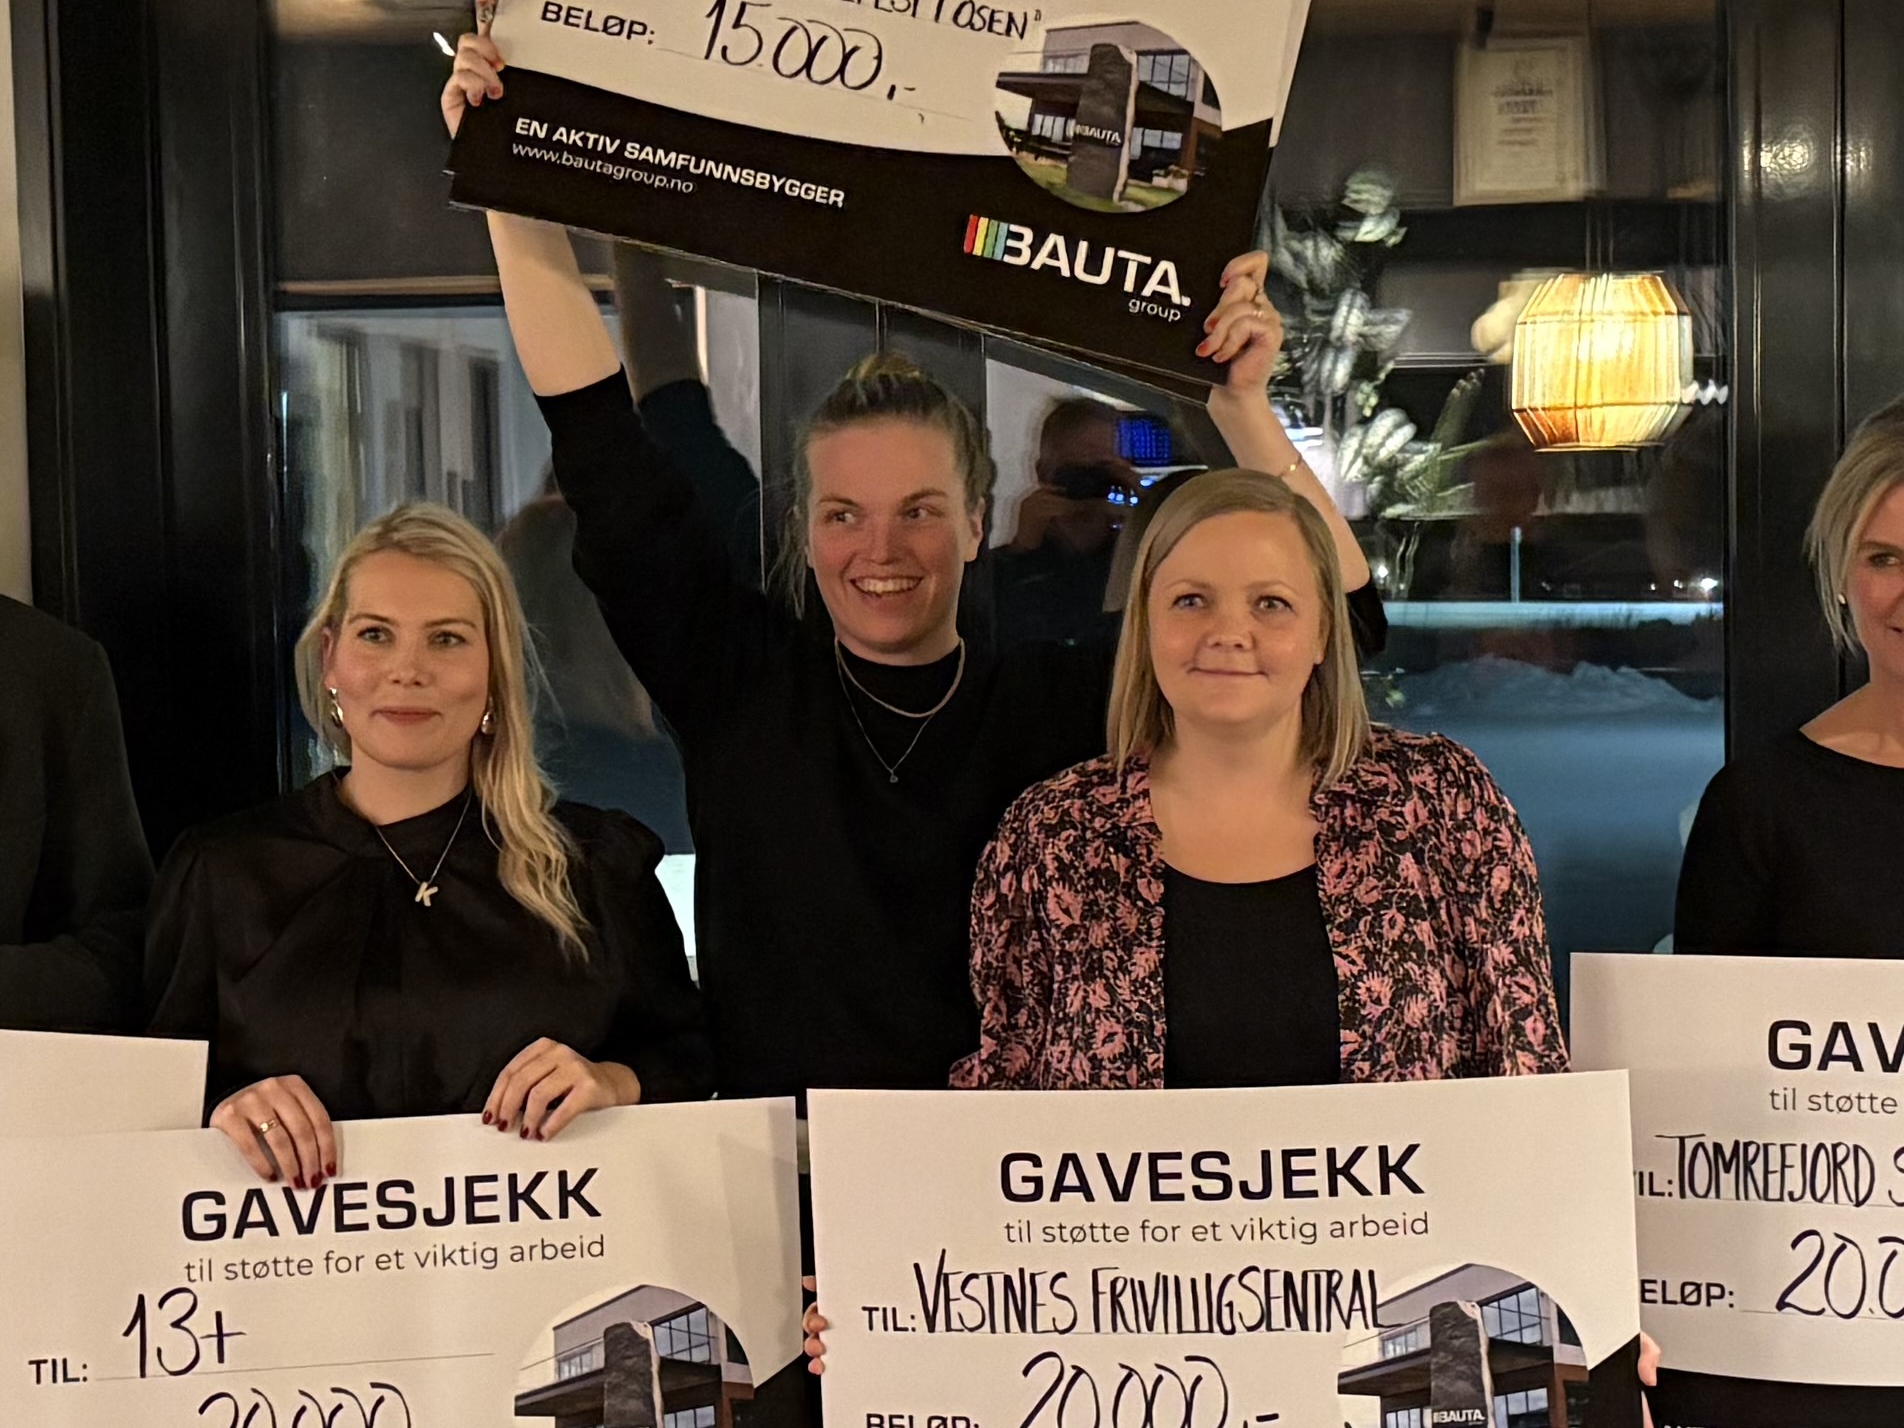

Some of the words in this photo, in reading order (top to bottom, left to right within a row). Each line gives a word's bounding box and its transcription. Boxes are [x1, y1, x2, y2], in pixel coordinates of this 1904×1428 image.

[540, 0, 655, 45] BELØP:
[512, 142, 695, 196] www.bautagroup.no
[515, 117, 549, 139] EN
[552, 126, 621, 154] AKTIV
[623, 141, 845, 208] SAMFUNNSBYGGER
[1128, 298, 1181, 323] group
[1768, 1086, 1797, 1111] til
[1807, 1091, 1899, 1115] støtte
[1000, 1143, 1425, 1203] GAVESJEKK
[1633, 1171, 1673, 1199] IL:
[1654, 1133, 1877, 1208] TOMREFJORD
[180, 1167, 603, 1243] GAVESJEKK
[1003, 1219, 1032, 1244] til
[1042, 1222, 1130, 1245] støtte
[1139, 1218, 1181, 1243] for
[1191, 1221, 1223, 1242] et
[1230, 1216, 1318, 1246] viktig
[1329, 1210, 1429, 1239] arbeid
[184, 1258, 213, 1284] til
[223, 1256, 314, 1281] støtte
[323, 1249, 365, 1275] for
[375, 1249, 406, 1271] et
[413, 1241, 498, 1270] viktig
[509, 1233, 605, 1263] arbeid
[861, 1305, 917, 1333] TIL:
[912, 1248, 1078, 1335] VESTNES
[1639, 1278, 1736, 1310] ELØP:
[27, 1357, 88, 1385] TIL:
[122, 1286, 247, 1379] 13+
